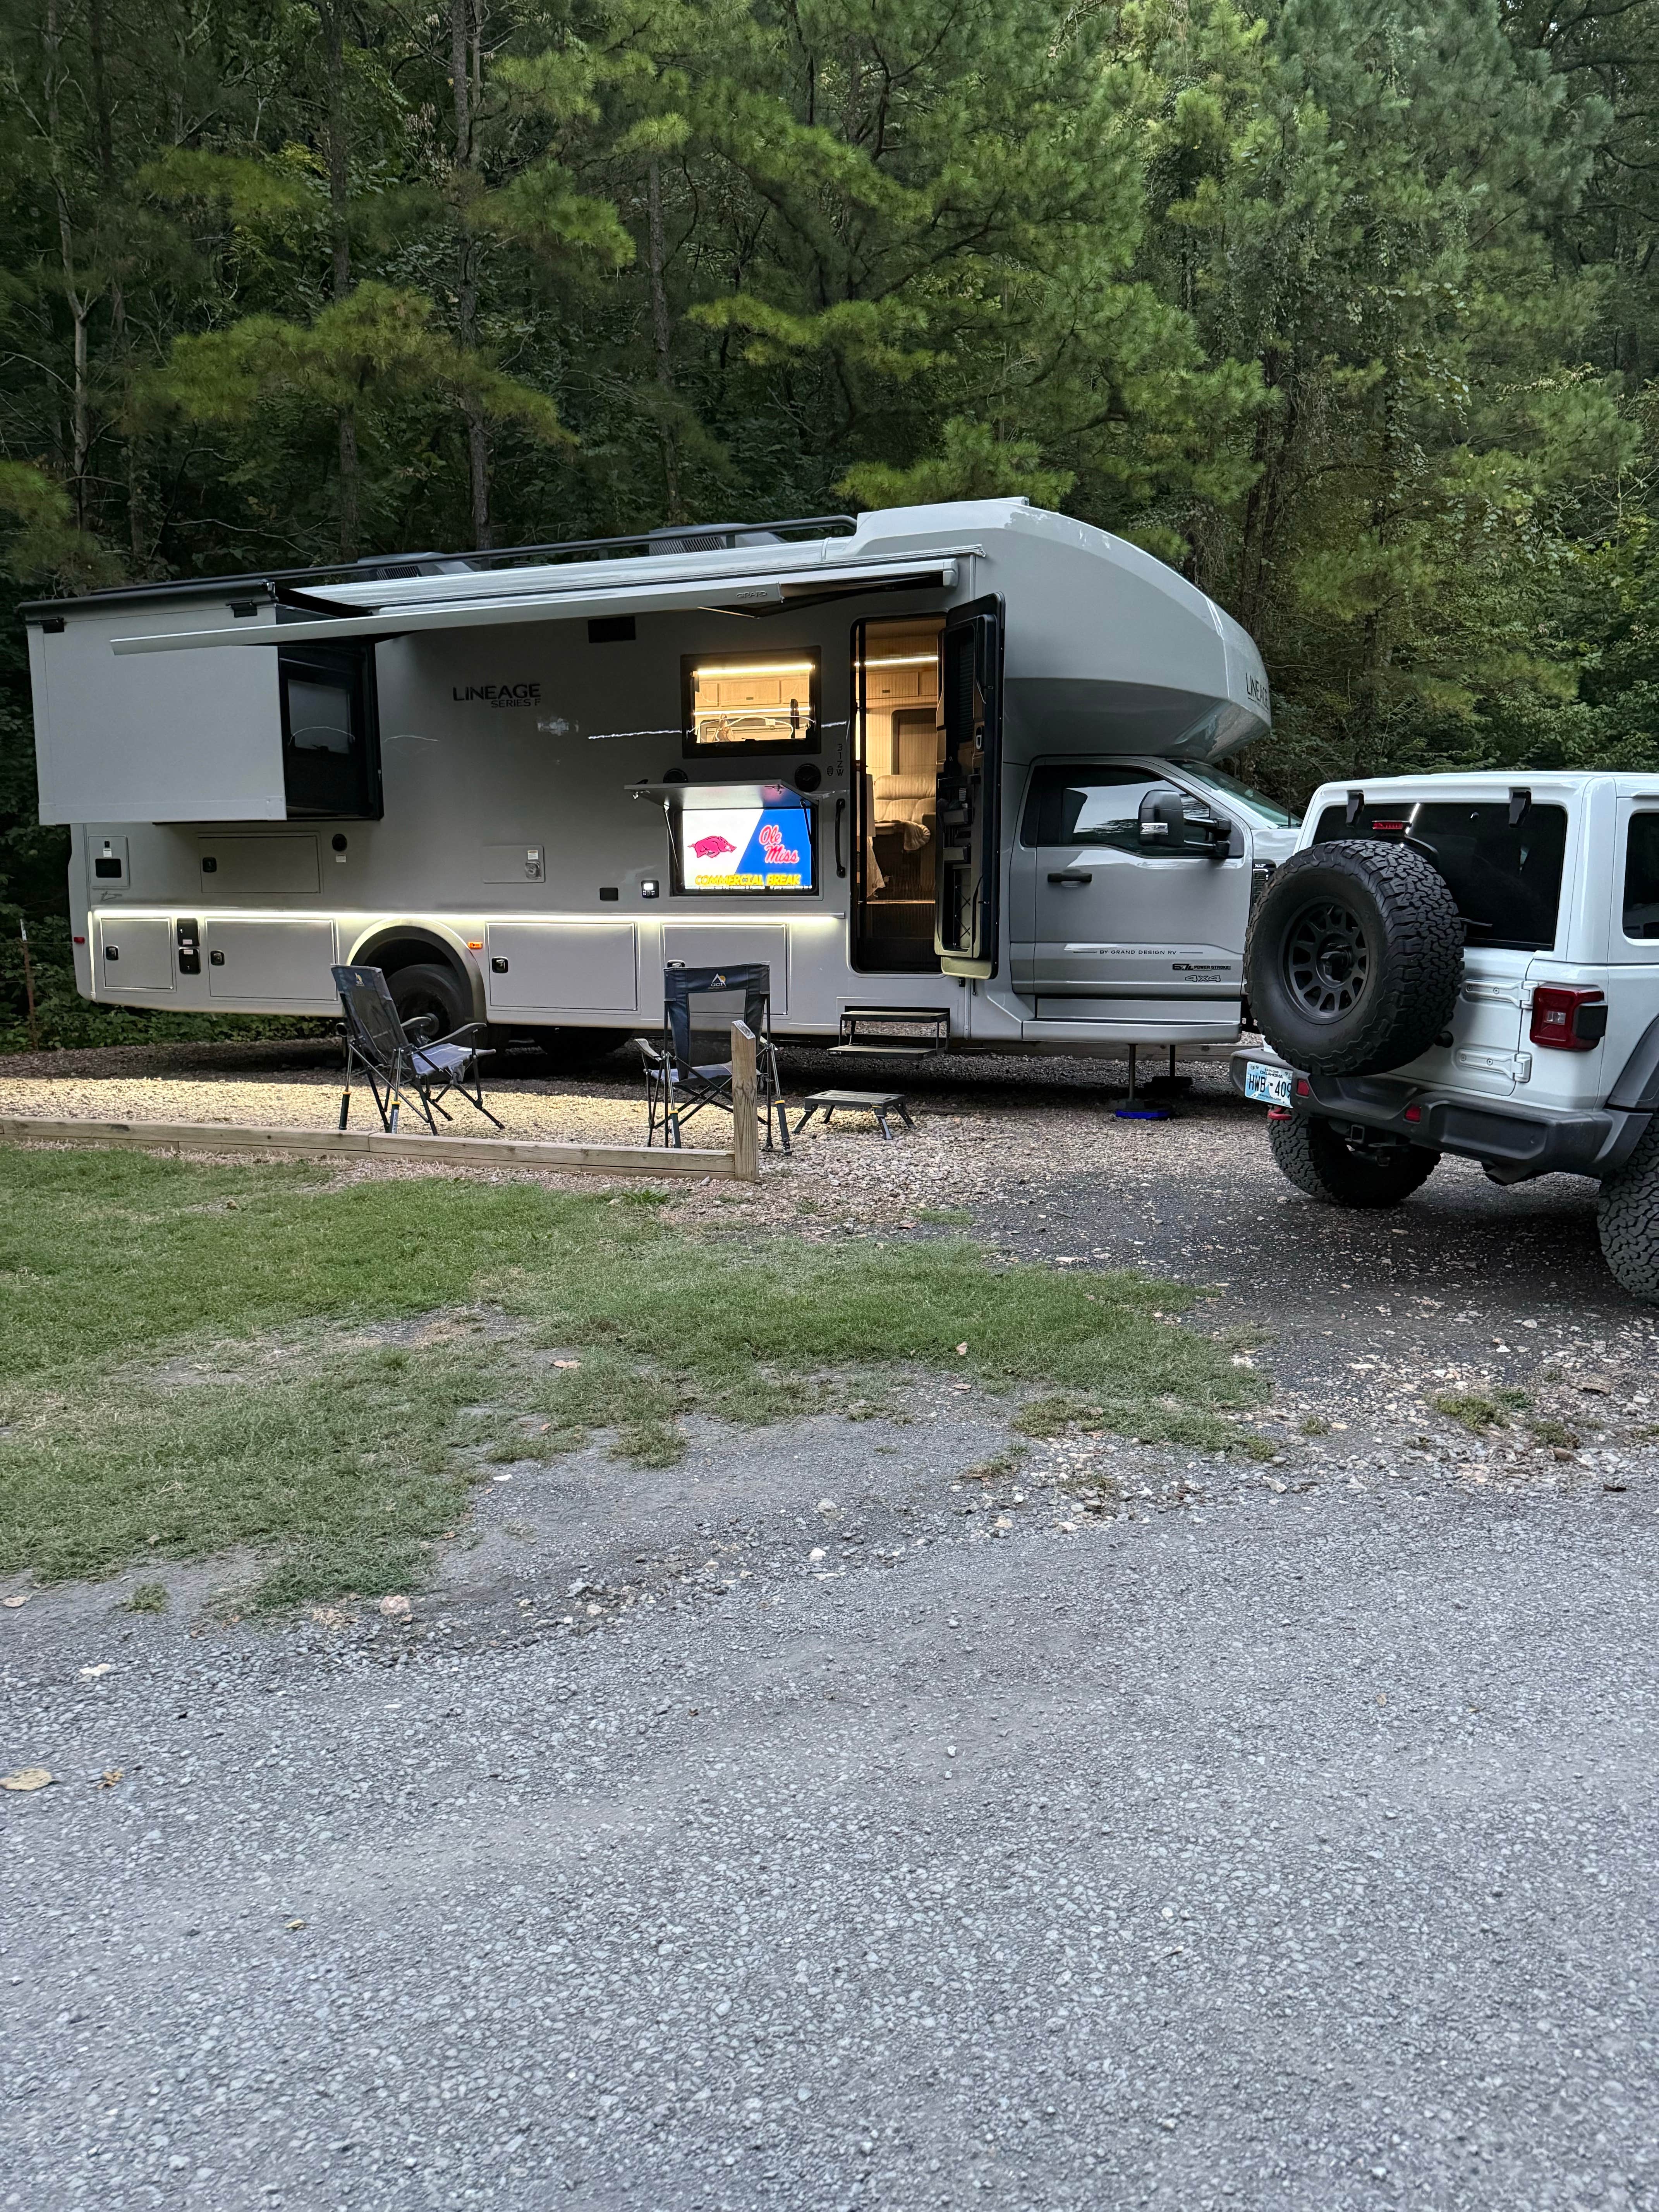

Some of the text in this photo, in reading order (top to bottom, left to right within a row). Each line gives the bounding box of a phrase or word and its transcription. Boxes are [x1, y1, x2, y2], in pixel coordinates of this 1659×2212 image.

[453, 684, 541, 701] LINEAGE
[491, 699, 531, 708] SERIES
[759, 824, 782, 845] Ole
[764, 844, 800, 864] Miss
[695, 874, 801, 885] COMMERCIAL BREAK
[1260, 1070, 1283, 1079] OKLAHOMA
